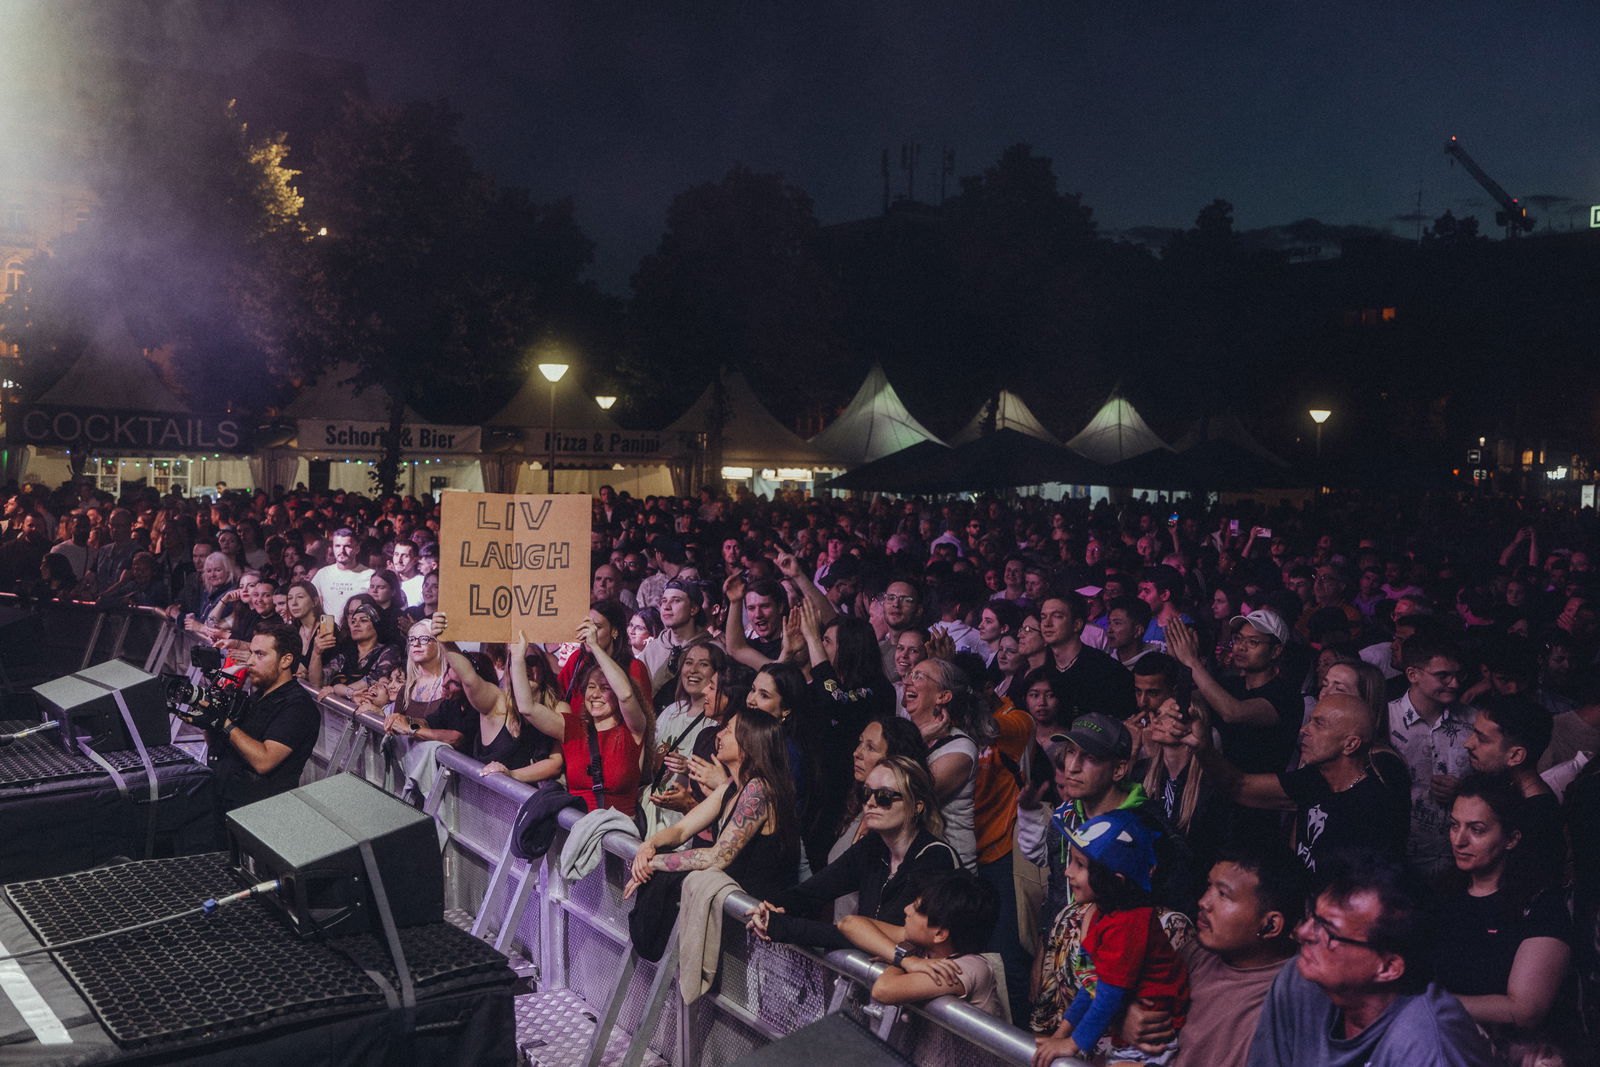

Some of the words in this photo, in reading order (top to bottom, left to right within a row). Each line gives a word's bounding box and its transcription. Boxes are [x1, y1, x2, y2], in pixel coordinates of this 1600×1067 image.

[22, 410, 239, 449] COCKTAILS
[400, 427, 412, 447] &
[420, 429, 455, 449] Bier
[593, 432, 604, 452] &
[609, 433, 661, 453] Panini
[477, 500, 552, 530] LIV
[460, 541, 570, 570] LAUGH
[470, 584, 558, 618] LOVE
